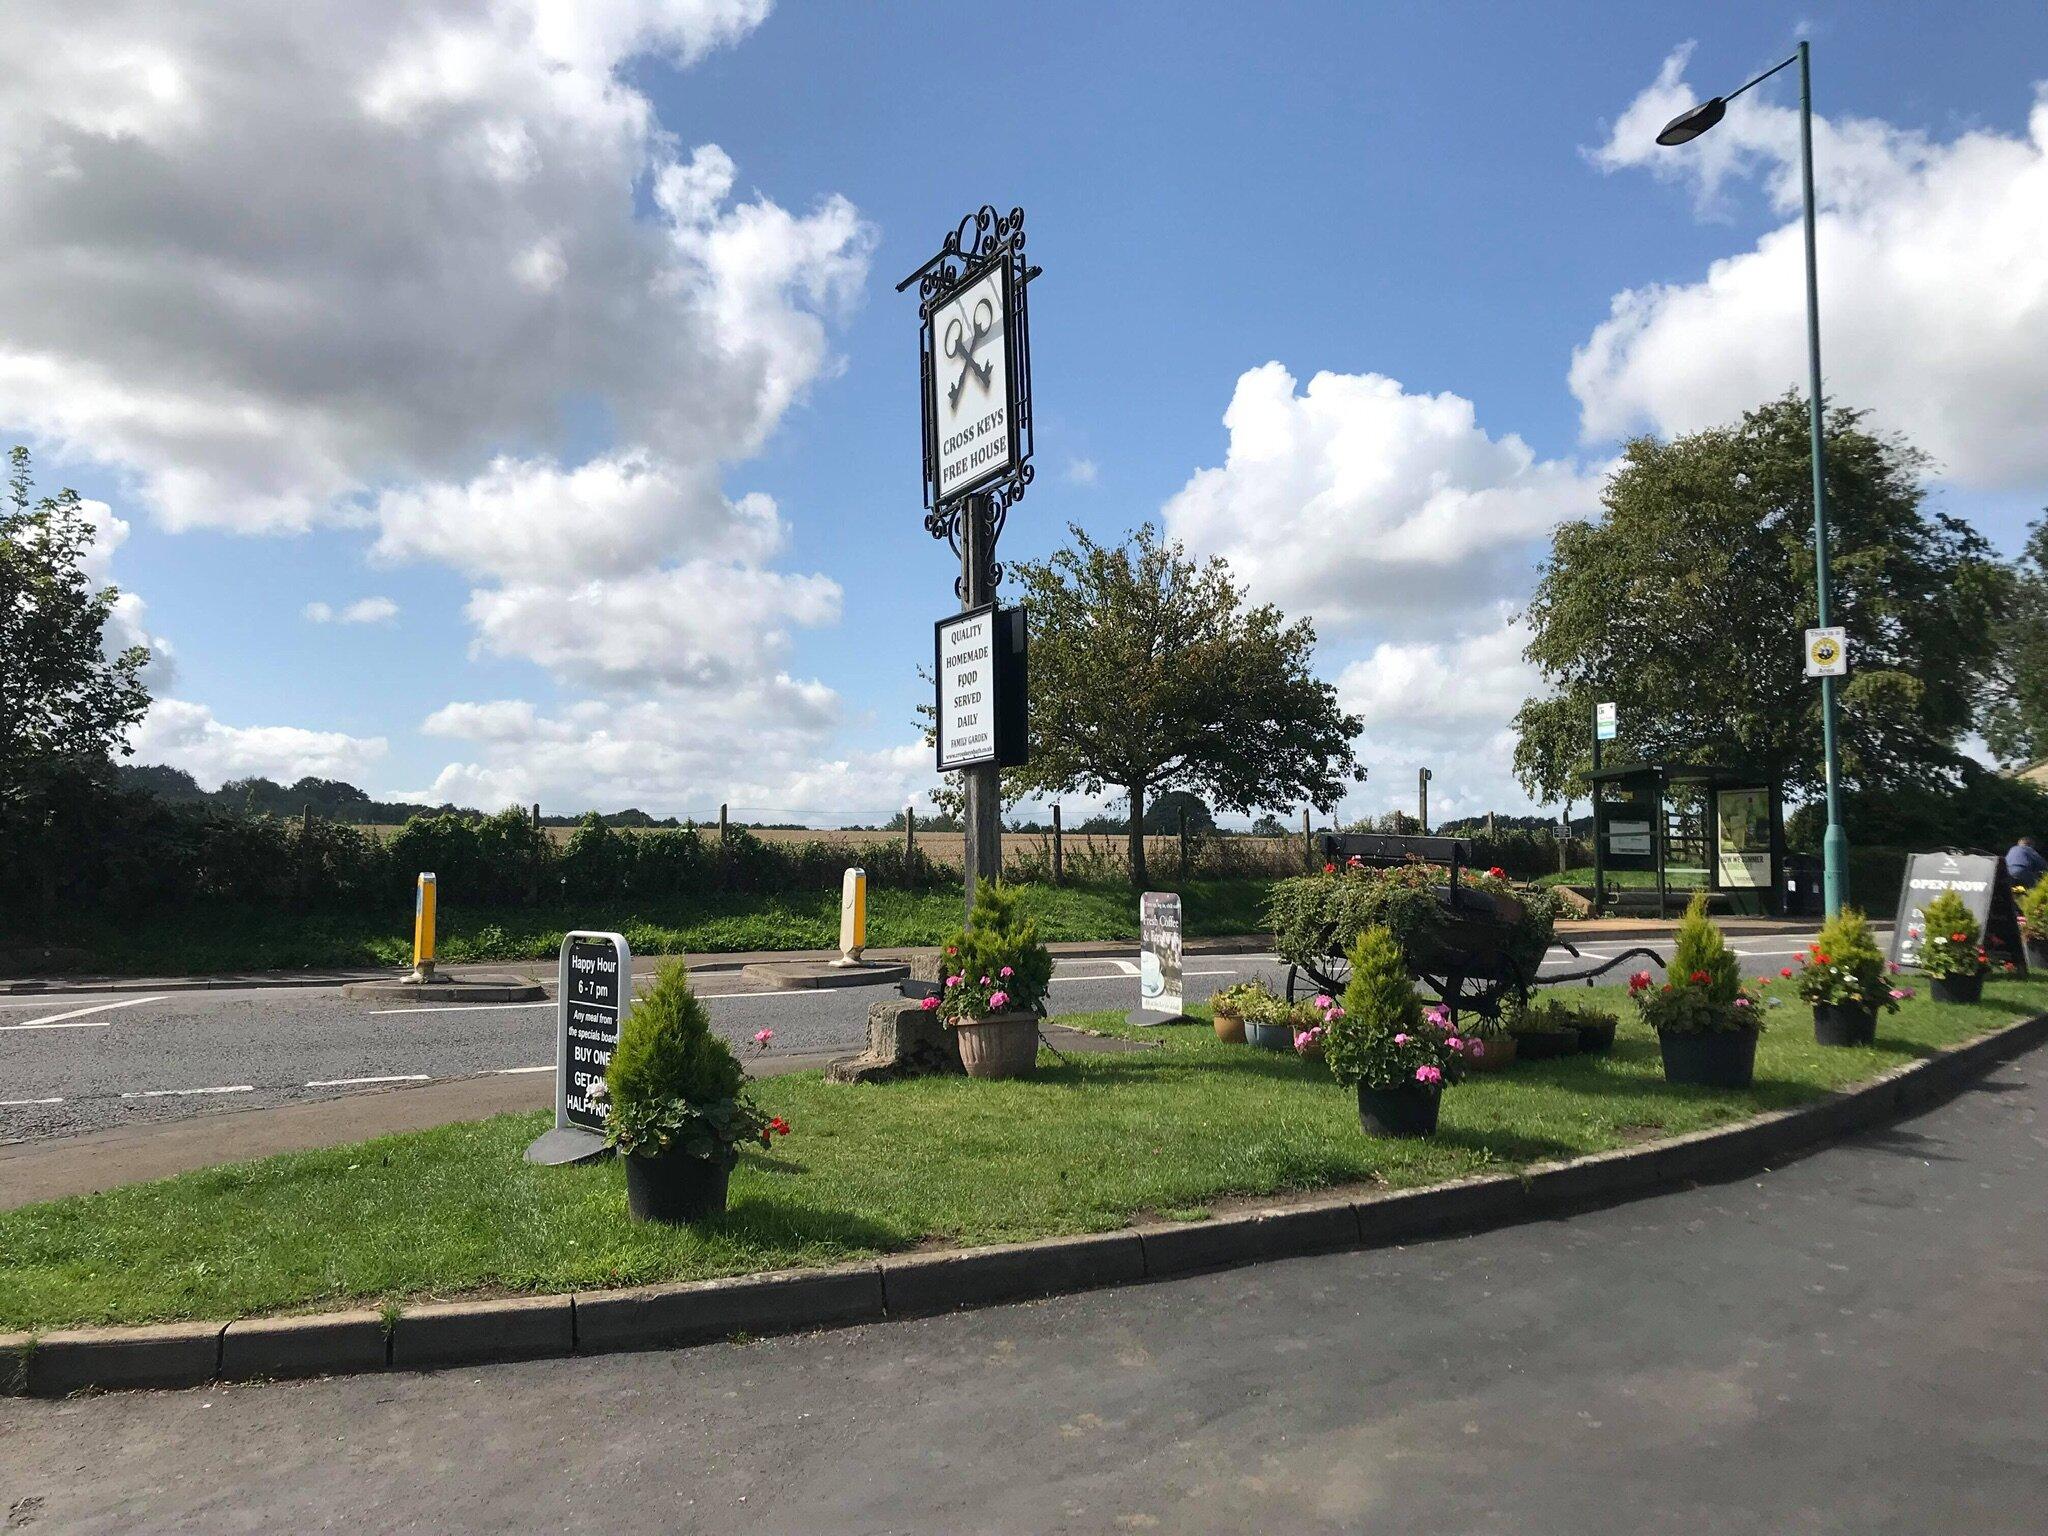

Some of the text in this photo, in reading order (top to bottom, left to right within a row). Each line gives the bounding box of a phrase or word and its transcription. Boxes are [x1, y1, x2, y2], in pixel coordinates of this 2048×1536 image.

[944, 408, 1004, 456] CROSS KEYS
[943, 436, 1007, 484] FREE HOUSE
[951, 623, 982, 645] QUALITY
[946, 646, 989, 668] HOMEMADE
[958, 670, 978, 687] FOOD
[954, 691, 982, 708] SERVED
[957, 713, 978, 728] DAILY
[951, 732, 988, 748] FAMILY GARDEN
[1909, 878, 1987, 891] OPEN NOW
[1143, 914, 1179, 928] Fresh Coffee
[572, 955, 616, 974] Happy Hour
[578, 979, 583, 993] 6
[589, 981, 594, 995] 7
[595, 985, 608, 999] pm
[573, 1009, 613, 1024] Any meal from
[568, 1025, 618, 1044] the specials board
[574, 1045, 611, 1066] BUY ONE
[574, 1070, 591, 1087] GET
[567, 1093, 588, 1113] HALF
